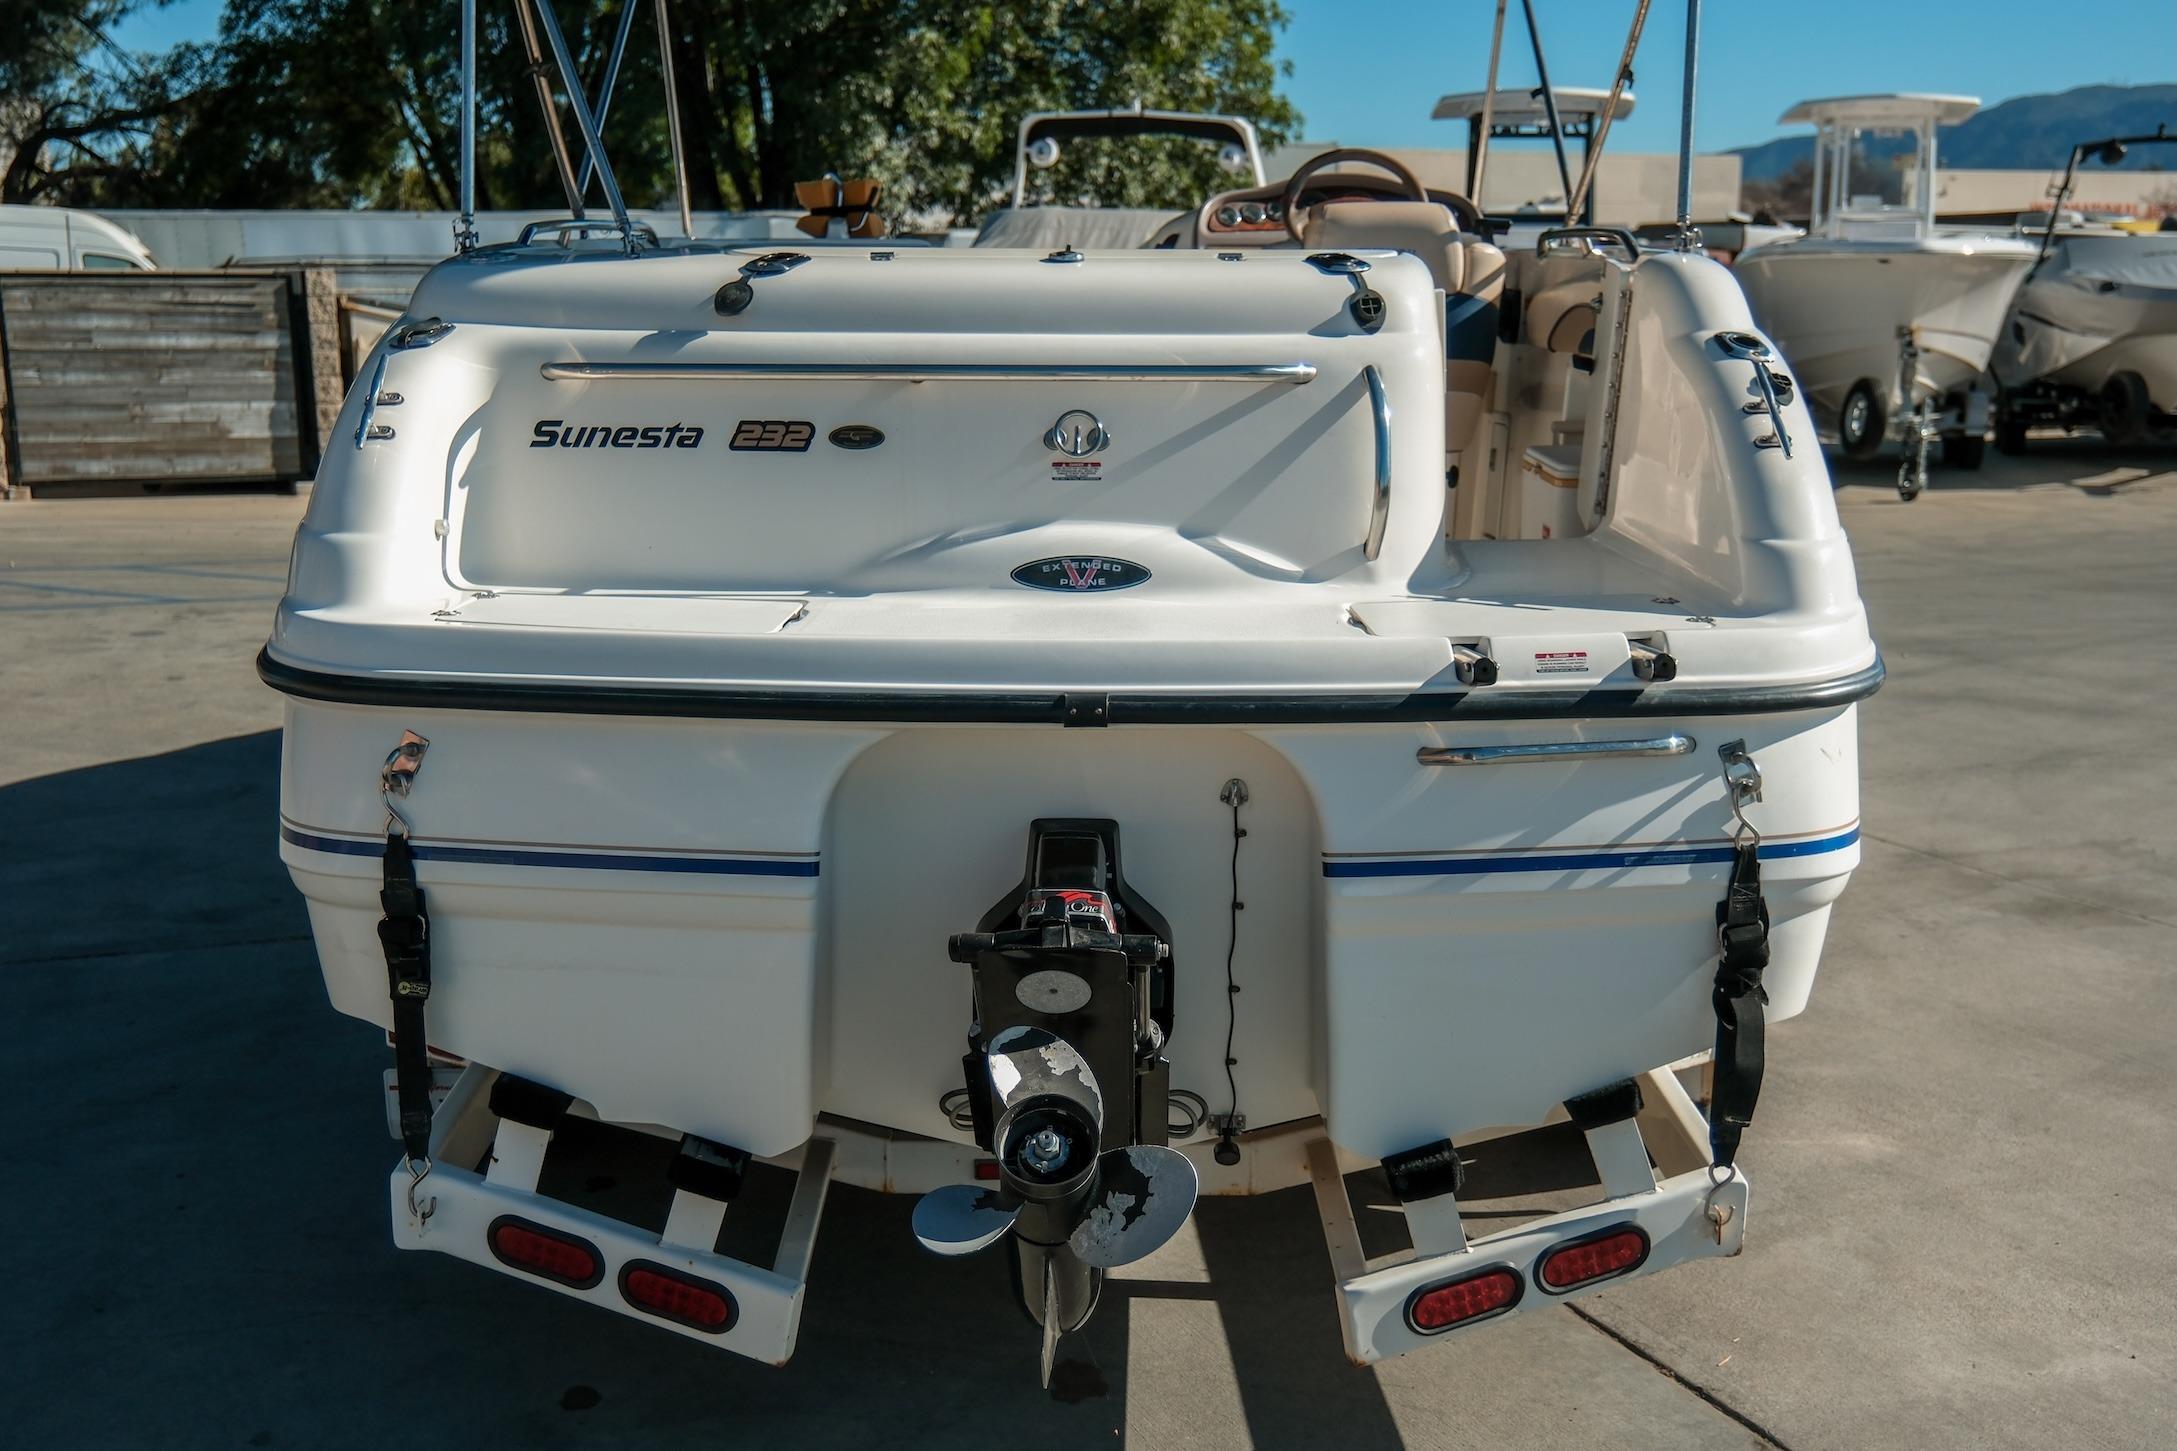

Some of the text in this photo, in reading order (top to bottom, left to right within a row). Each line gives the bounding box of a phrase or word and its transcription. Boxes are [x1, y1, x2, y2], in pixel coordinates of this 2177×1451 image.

[529, 420, 704, 448] Sunesta
[732, 421, 813, 450] 232
[1042, 561, 1122, 572] EXTENDED
[1060, 578, 1106, 586] PLANE
[1071, 901, 1099, 912] One
